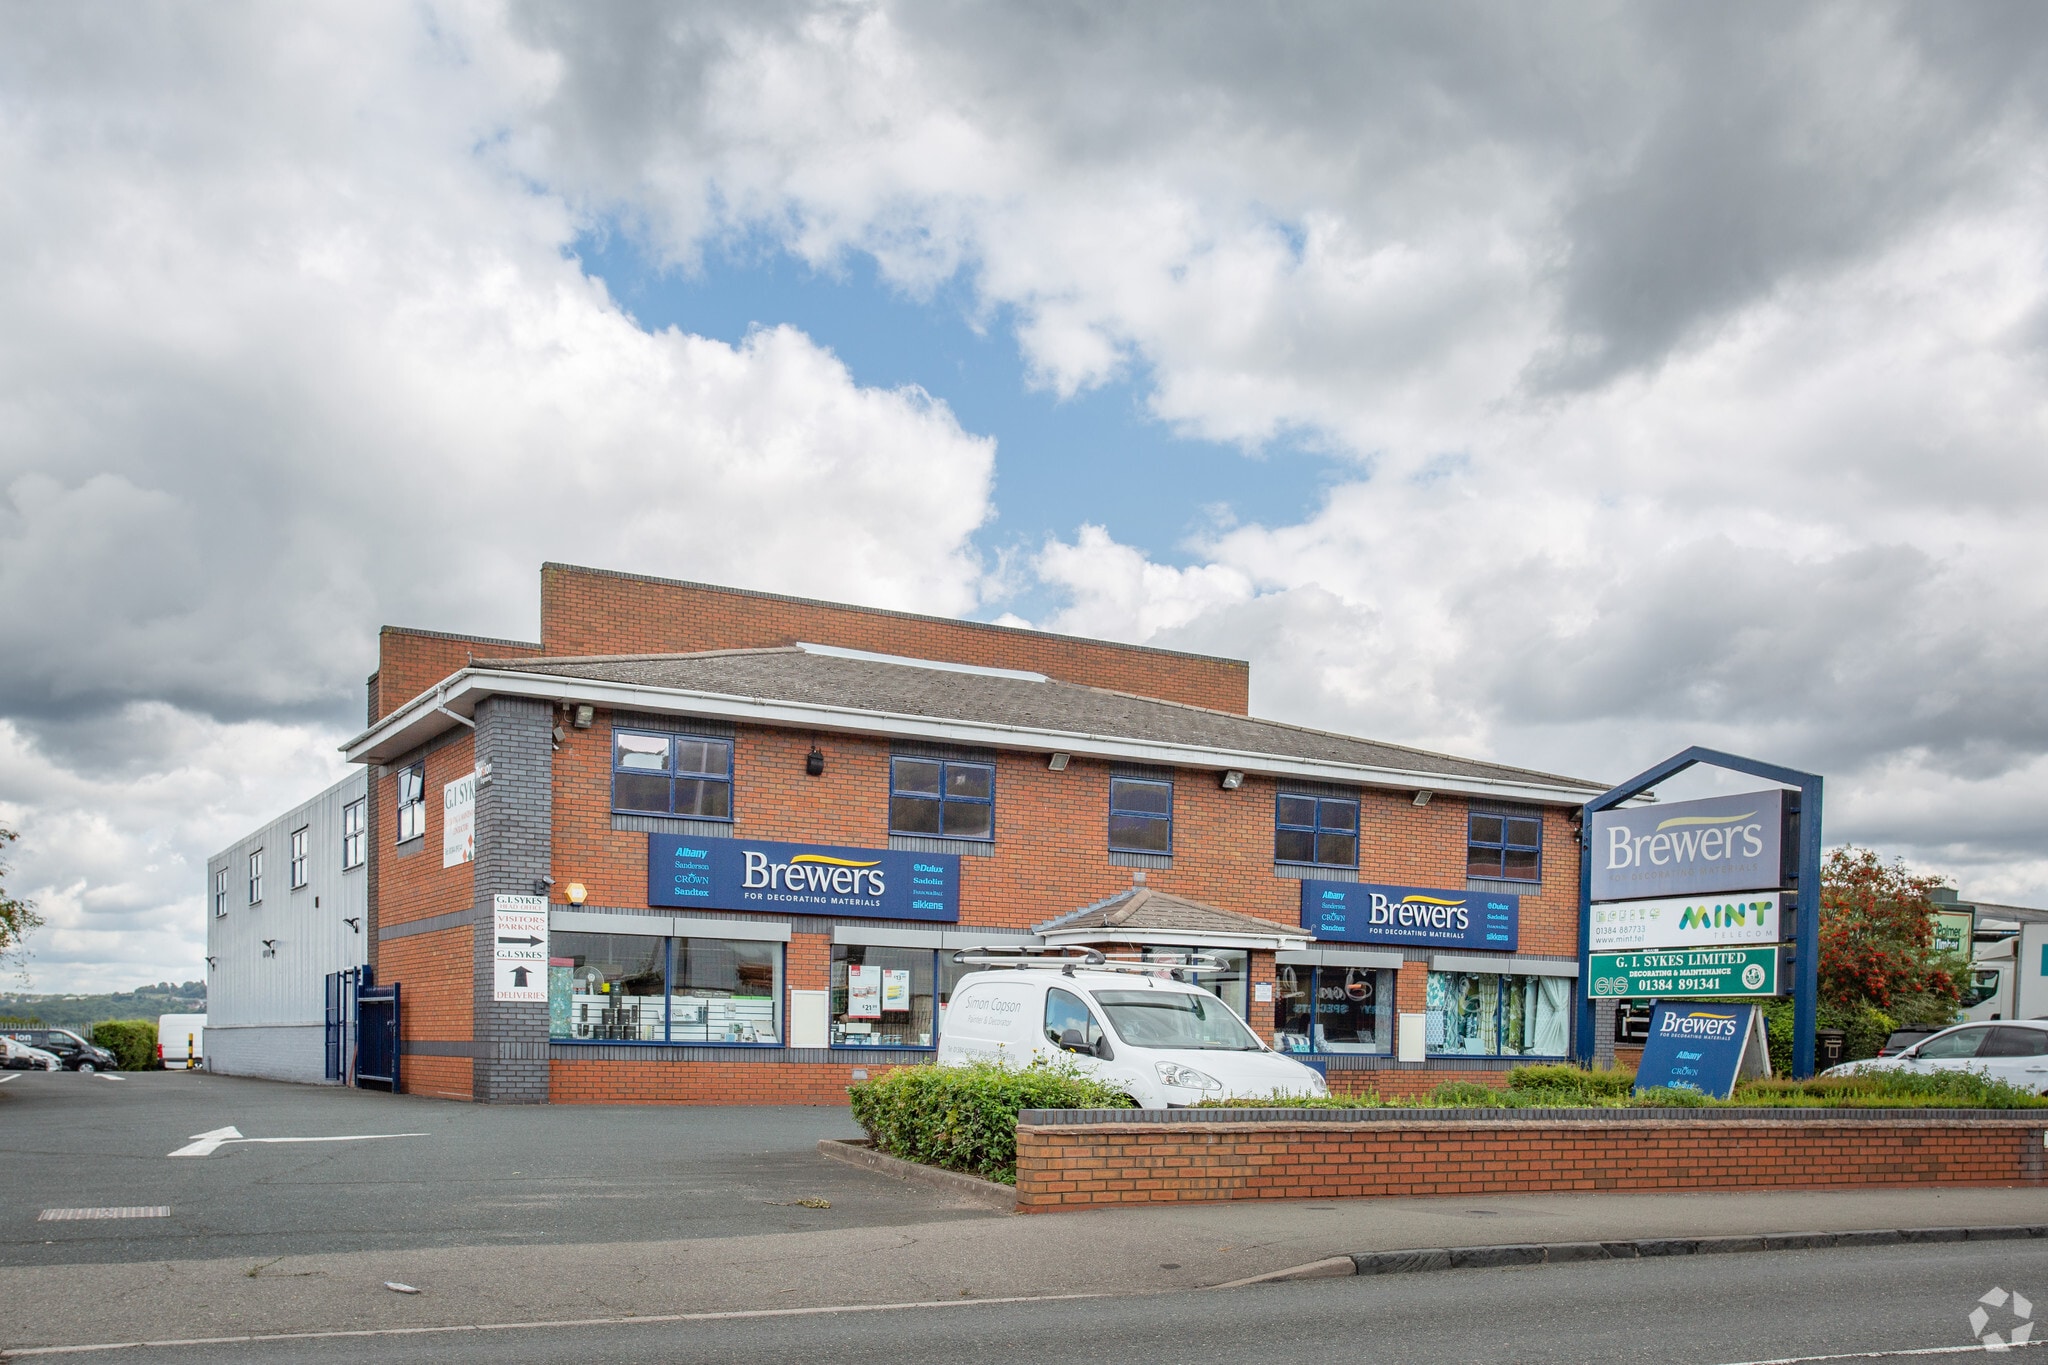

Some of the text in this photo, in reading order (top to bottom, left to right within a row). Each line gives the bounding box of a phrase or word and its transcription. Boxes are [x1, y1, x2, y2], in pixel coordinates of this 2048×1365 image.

[1605, 823, 1763, 870] Brewers
[675, 847, 708, 859] Albany
[674, 861, 710, 870] Sanderson
[741, 850, 886, 896] Brewers
[1609, 862, 1759, 881] FOR DECORATING MATERIALS
[674, 873, 709, 884] CROWN
[913, 877, 943, 886] Sadolin
[674, 887, 710, 897] Sandtex
[1322, 890, 1345, 900] Albany
[514, 896, 542, 905] SYKES
[744, 892, 881, 907] FOR DECORATING MATERIALS
[912, 900, 944, 910] sikkens
[1368, 893, 1469, 930] Brewers
[1679, 901, 1773, 930] MINT
[497, 915, 545, 923] VISITORS
[1321, 912, 1346, 922] CROWN
[498, 924, 545, 932] PARKING
[1596, 925, 1646, 935] 01384 887733
[1385, 928, 1426, 937] DECORATING
[1429, 931, 1465, 939] MATERIALS
[1714, 930, 1773, 939] TELECOM
[1596, 934, 1645, 944] www.mint.tel
[514, 951, 542, 959] SYKES
[1615, 952, 1747, 968] G. I. SYKES LIMITED
[1629, 969, 1672, 978] DECORATING
[1680, 968, 1732, 976] MAINTENANCE
[1638, 978, 1720, 991] 01384 891341
[497, 991, 545, 999] DELIVERIES
[965, 995, 1021, 1014] Simon Copson
[1659, 1011, 1737, 1036] Brewers
[1676, 1050, 1703, 1061] Albany
[1671, 1066, 1699, 1076] CROWN
